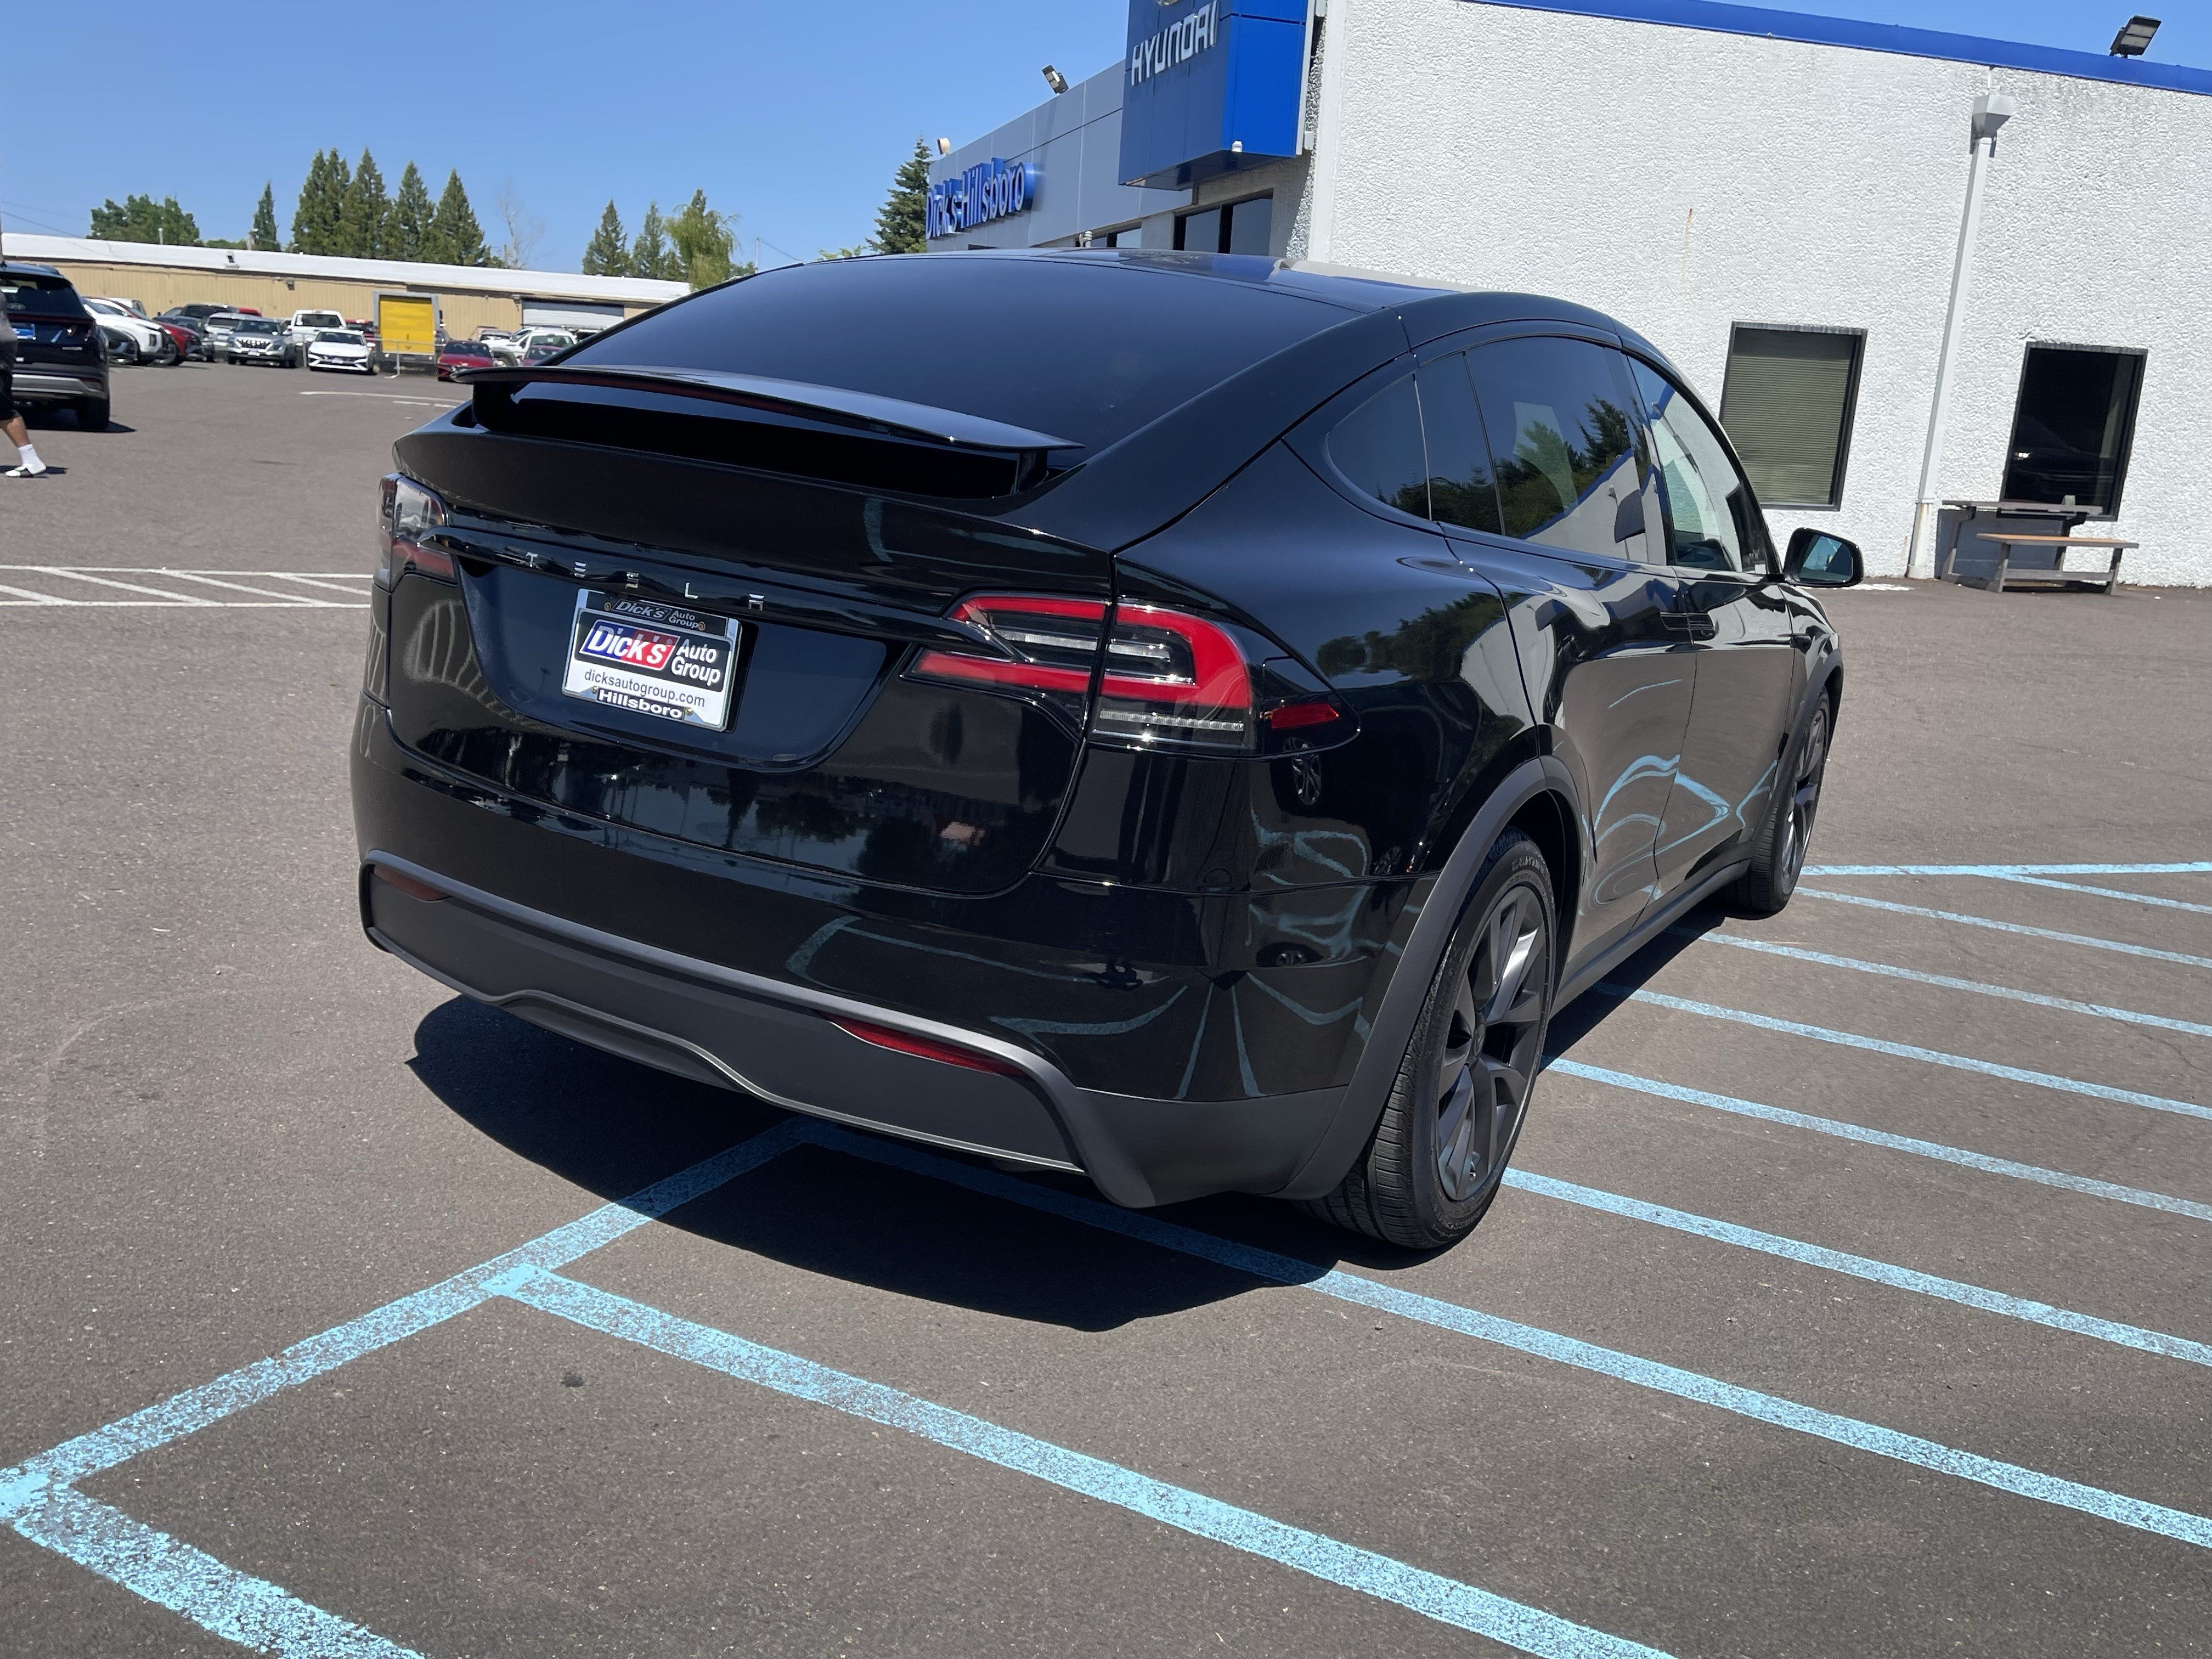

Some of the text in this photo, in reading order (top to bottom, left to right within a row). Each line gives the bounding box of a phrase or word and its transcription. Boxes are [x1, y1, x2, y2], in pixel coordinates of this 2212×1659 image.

[1131, 0, 1219, 86] HYUNDAI
[961, 158, 1026, 229] Hillsboro
[526, 551, 765, 611] TESLA
[669, 616, 699, 629] Group
[673, 610, 696, 621] Auto
[676, 638, 717, 663] Auto
[671, 656, 721, 686] Group
[584, 668, 705, 708] dicksautogroup.com
[599, 689, 683, 719] Hillsboro
